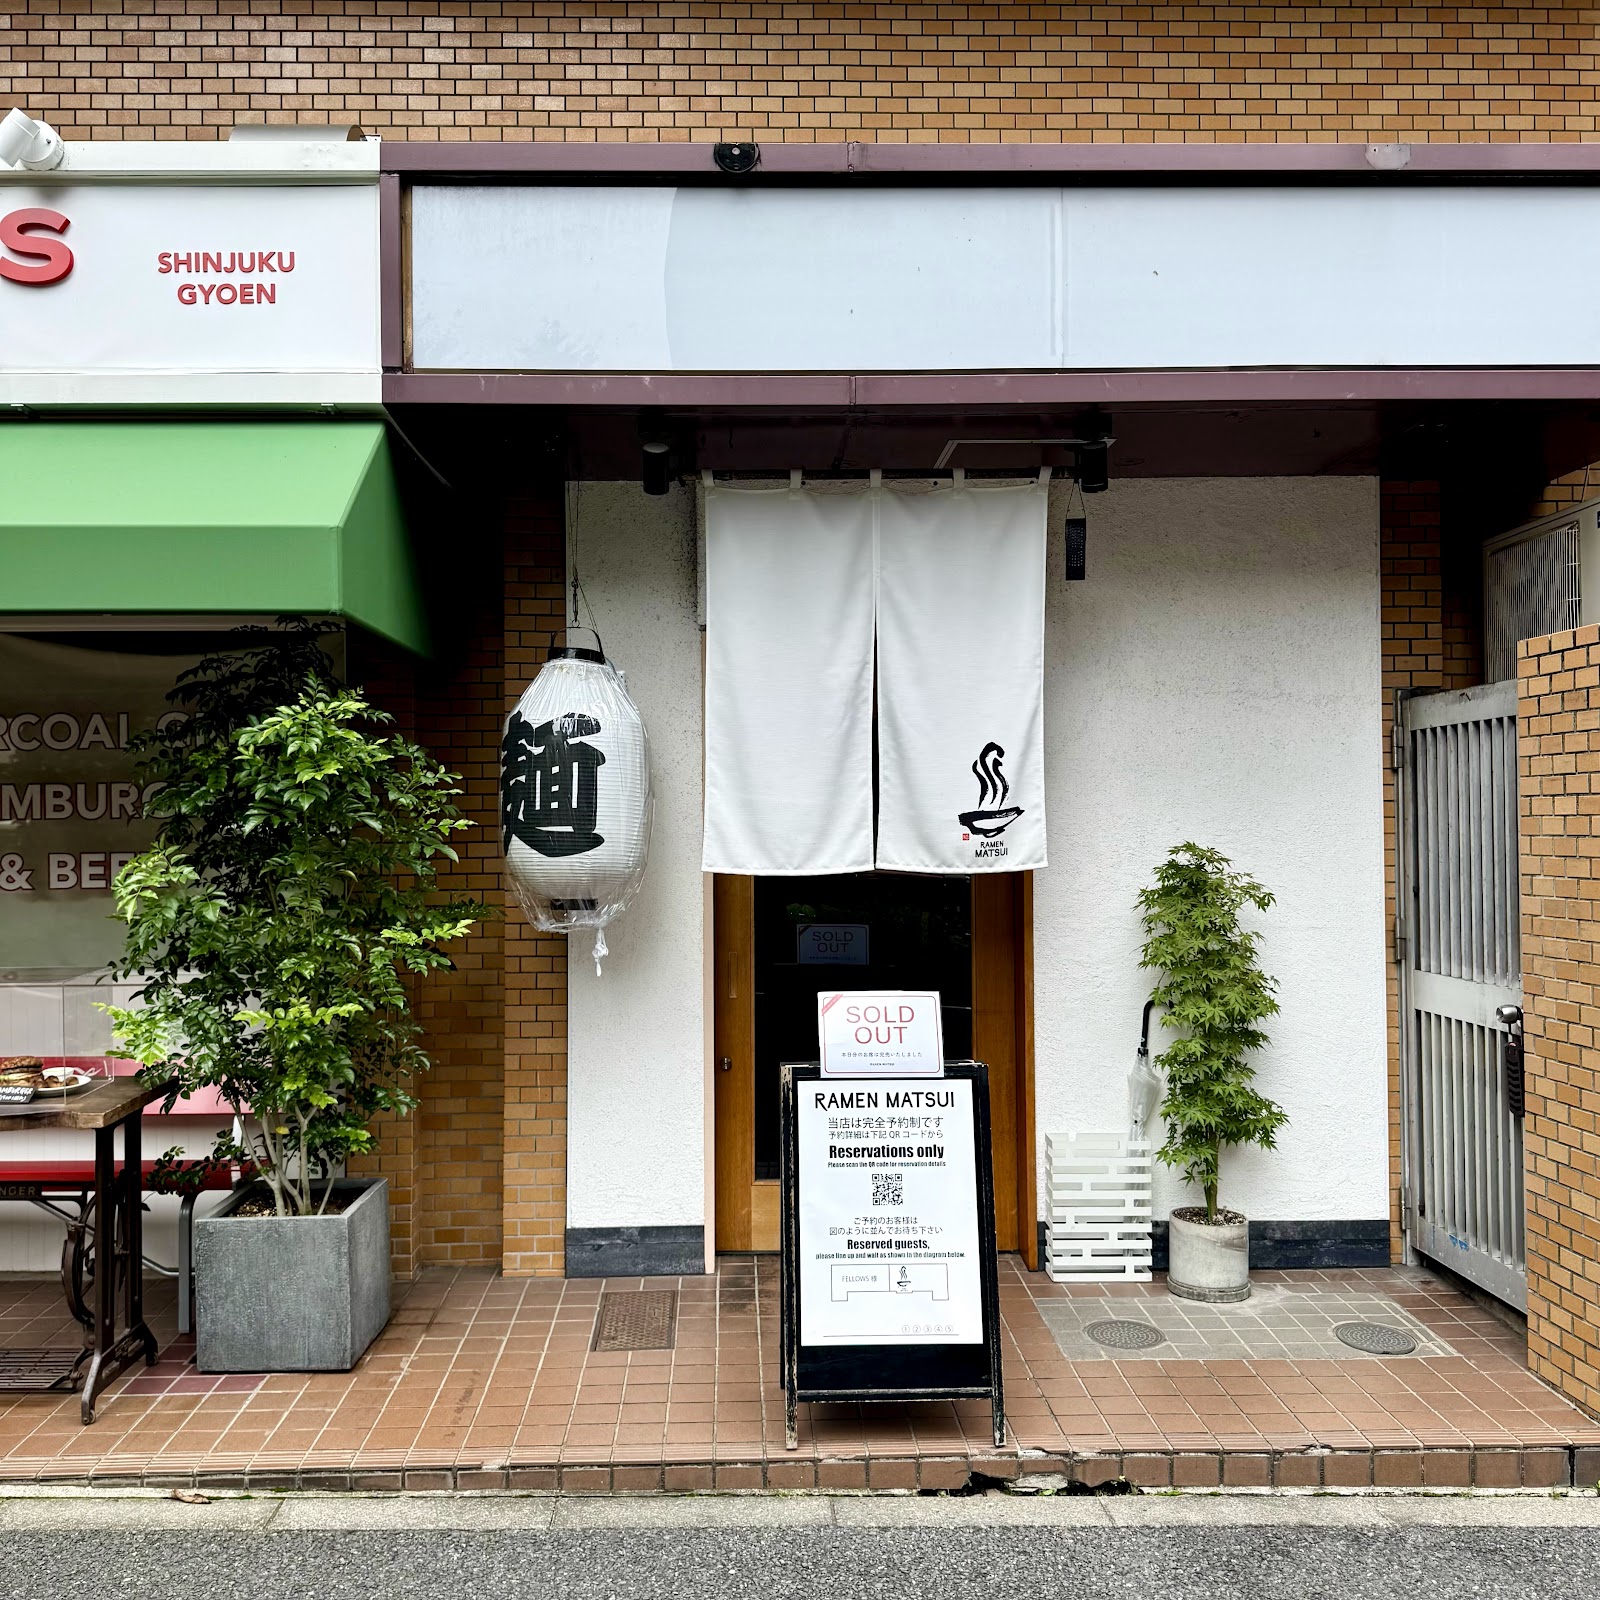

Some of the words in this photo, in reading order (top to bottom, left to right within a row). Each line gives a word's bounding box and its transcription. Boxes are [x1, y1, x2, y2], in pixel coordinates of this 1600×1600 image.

[0, 207, 75, 287] S
[157, 251, 296, 274] SHINJUKU
[177, 283, 277, 306] GYOEN
[501, 710, 606, 859] 麺
[980, 840, 1005, 850] RAMEN
[974, 847, 1009, 858] MATSUI
[0, 852, 35, 891] &
[812, 931, 854, 942] SOLD
[817, 942, 850, 953] OUT
[846, 1005, 915, 1024] SOLD
[854, 1026, 908, 1045] OUT
[814, 1092, 878, 1112] RAMEN
[886, 1091, 955, 1108] MATSUI
[828, 1116, 944, 1129] 当店は完全予約制です
[828, 1145, 914, 1159] Reservations
[916, 1143, 945, 1159] only
[0, 1186, 36, 1196] NGER
[853, 1216, 919, 1226] ご予約のお客様は
[829, 1226, 944, 1236] 図のように並んでお待ち下さい
[847, 1239, 893, 1250] Reserved
[894, 1238, 931, 1251] guests,
[815, 1252, 835, 1260] please
[923, 1251, 947, 1259] diagram
[841, 1275, 870, 1283] FELLOWS
